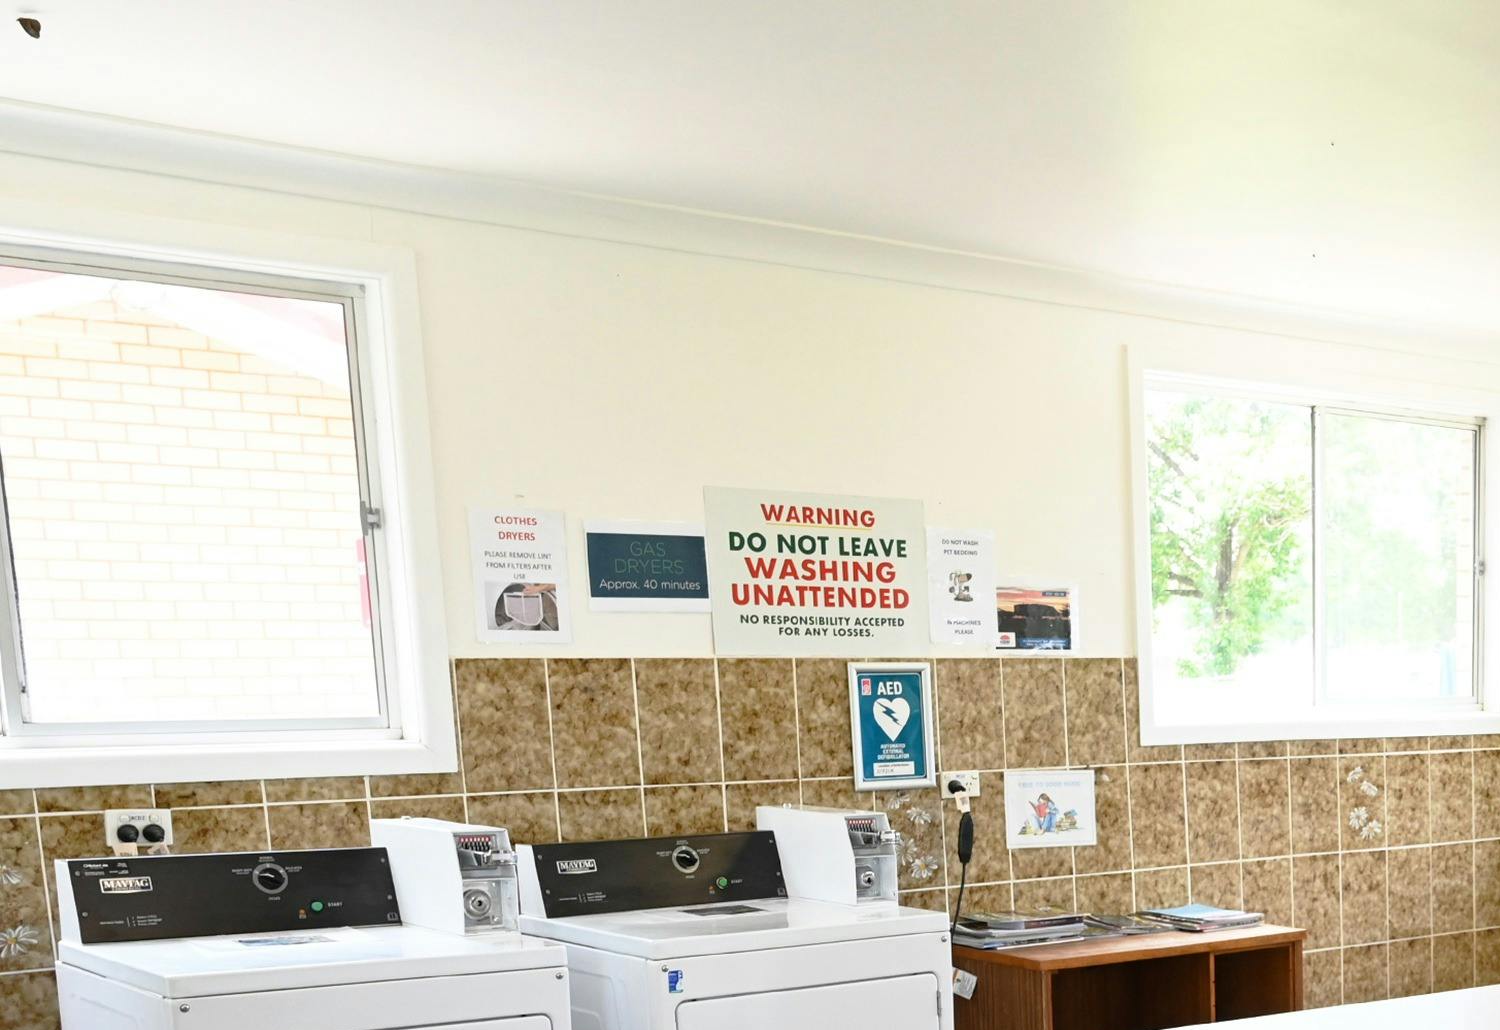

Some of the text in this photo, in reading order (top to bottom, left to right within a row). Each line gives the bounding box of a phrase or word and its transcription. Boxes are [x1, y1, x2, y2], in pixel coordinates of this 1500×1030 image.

[494, 515, 538, 526] CLOTHES
[760, 503, 875, 528] WARNING
[498, 531, 536, 541] DRYERS
[629, 541, 666, 557] GAS
[728, 531, 907, 558] DO NOT LEAVE
[484, 550, 507, 558] PLEASE
[509, 551, 536, 559] REMOVE
[507, 562, 531, 570] FILTERS
[613, 559, 684, 574] DRYERS
[744, 557, 896, 583] WASHING
[599, 579, 701, 591] Approx. 40 minutes
[731, 583, 910, 609] UNATTENDED
[740, 614, 905, 627] NO RESPONSIBILITY ACCEPTED
[778, 627, 875, 638] FOR ANY LOSSES.
[877, 681, 903, 696] AED
[560, 861, 595, 870] MAYTAG
[103, 879, 149, 889] MAYTAG
